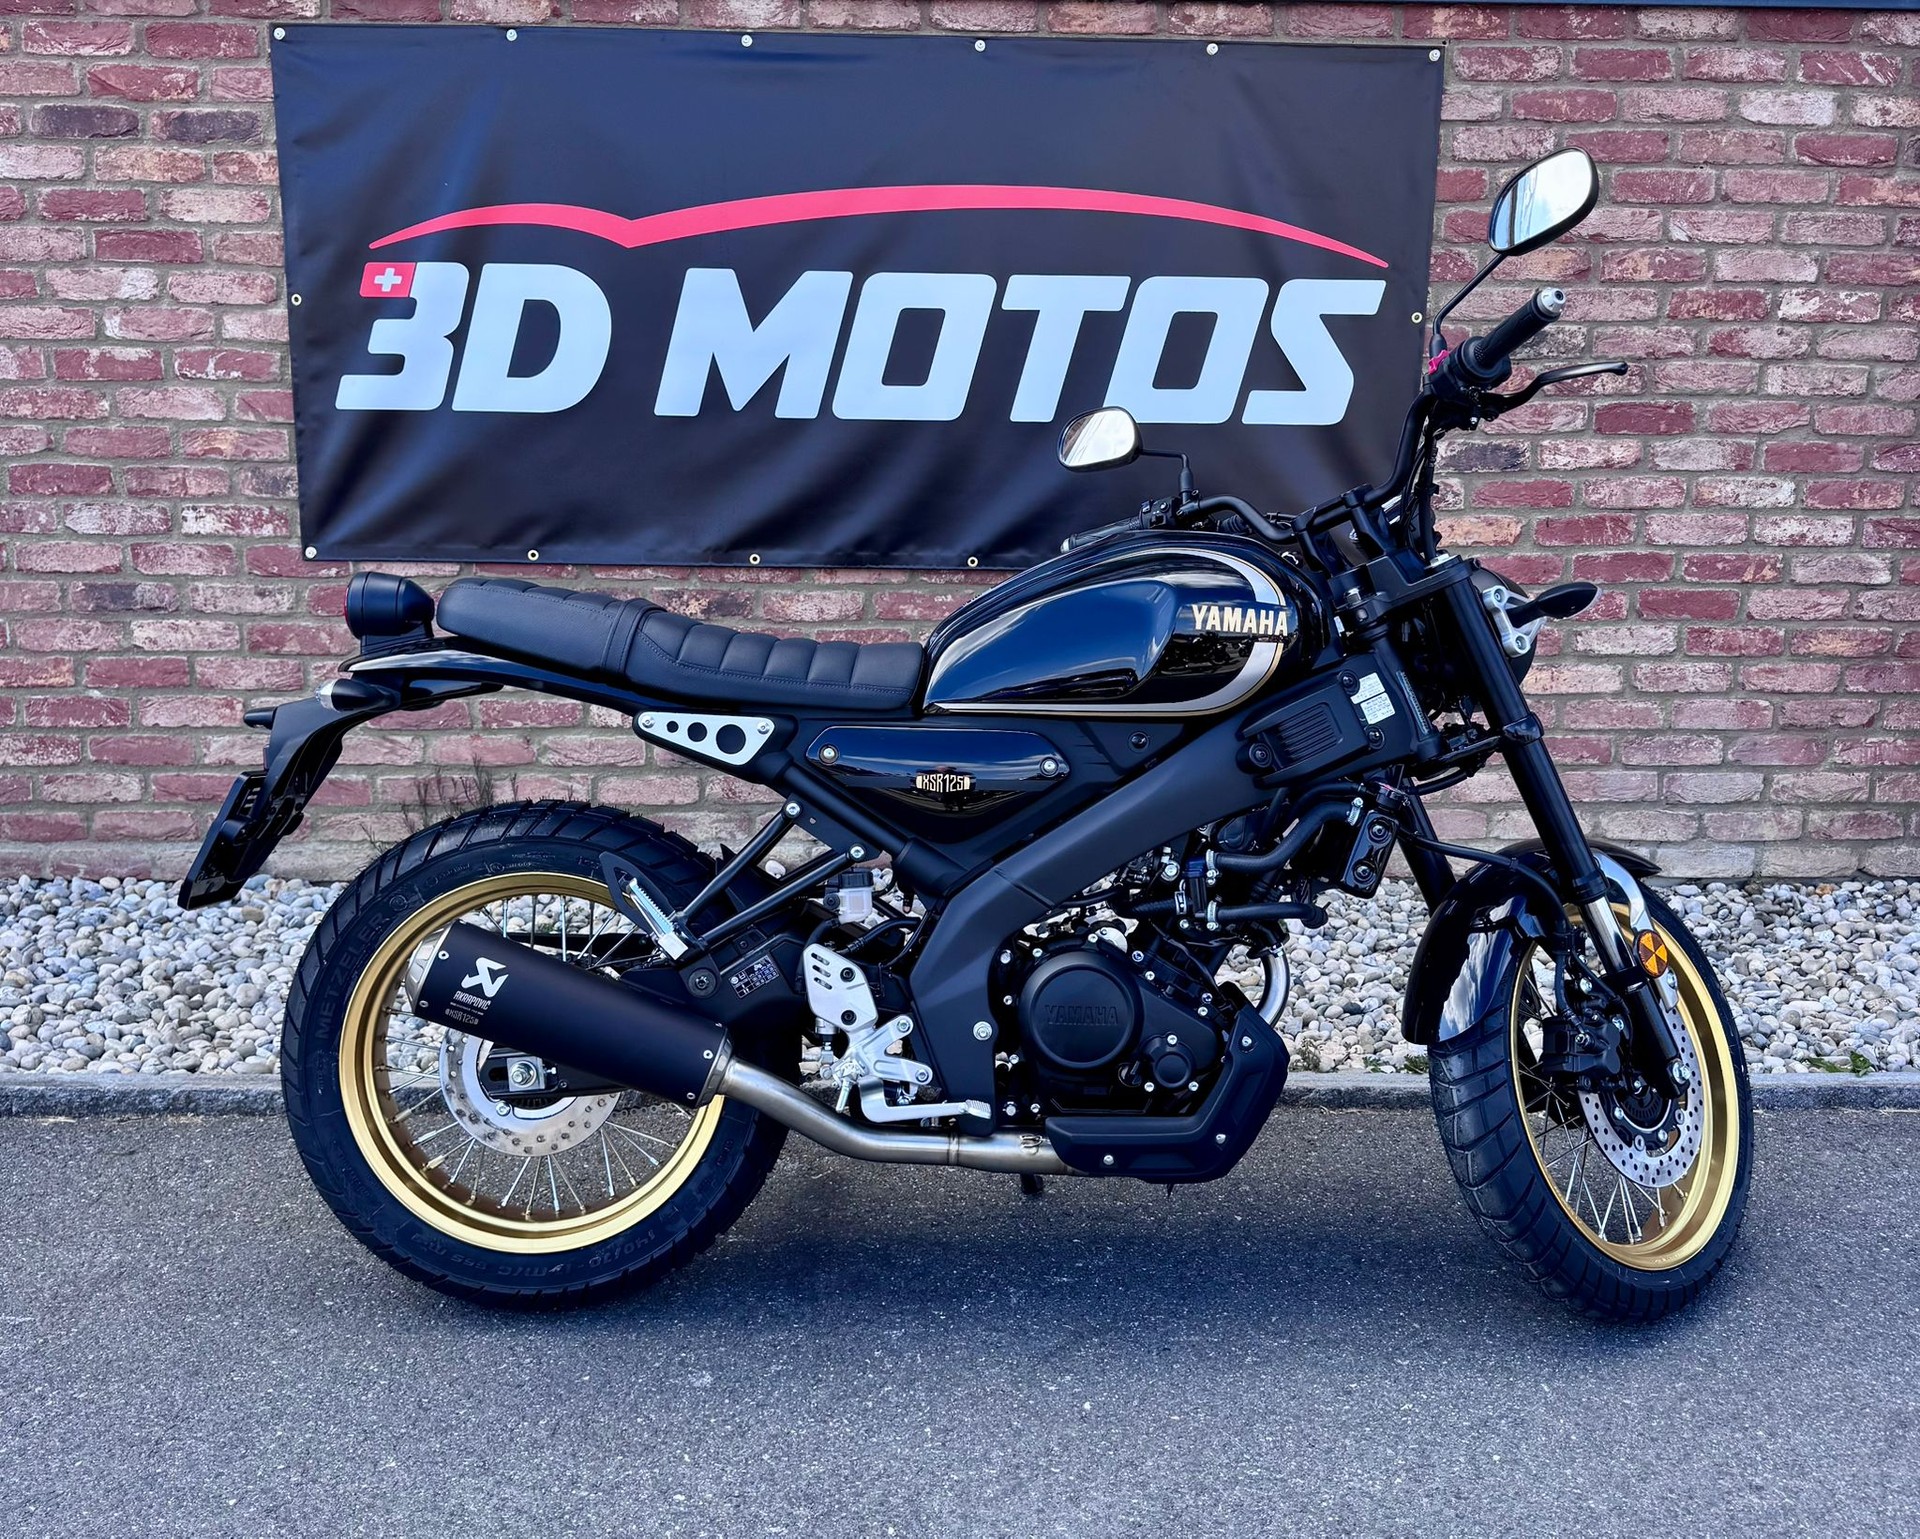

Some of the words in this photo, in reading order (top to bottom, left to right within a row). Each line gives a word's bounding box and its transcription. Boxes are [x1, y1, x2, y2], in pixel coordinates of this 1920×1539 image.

[336, 262, 612, 413] 3D
[653, 267, 1387, 426] MOTOS
[1192, 604, 1288, 637] YAMAHA
[922, 773, 964, 793] XSR125
[315, 911, 386, 1039] METZELER
[1044, 1004, 1119, 1026] YAMAHA
